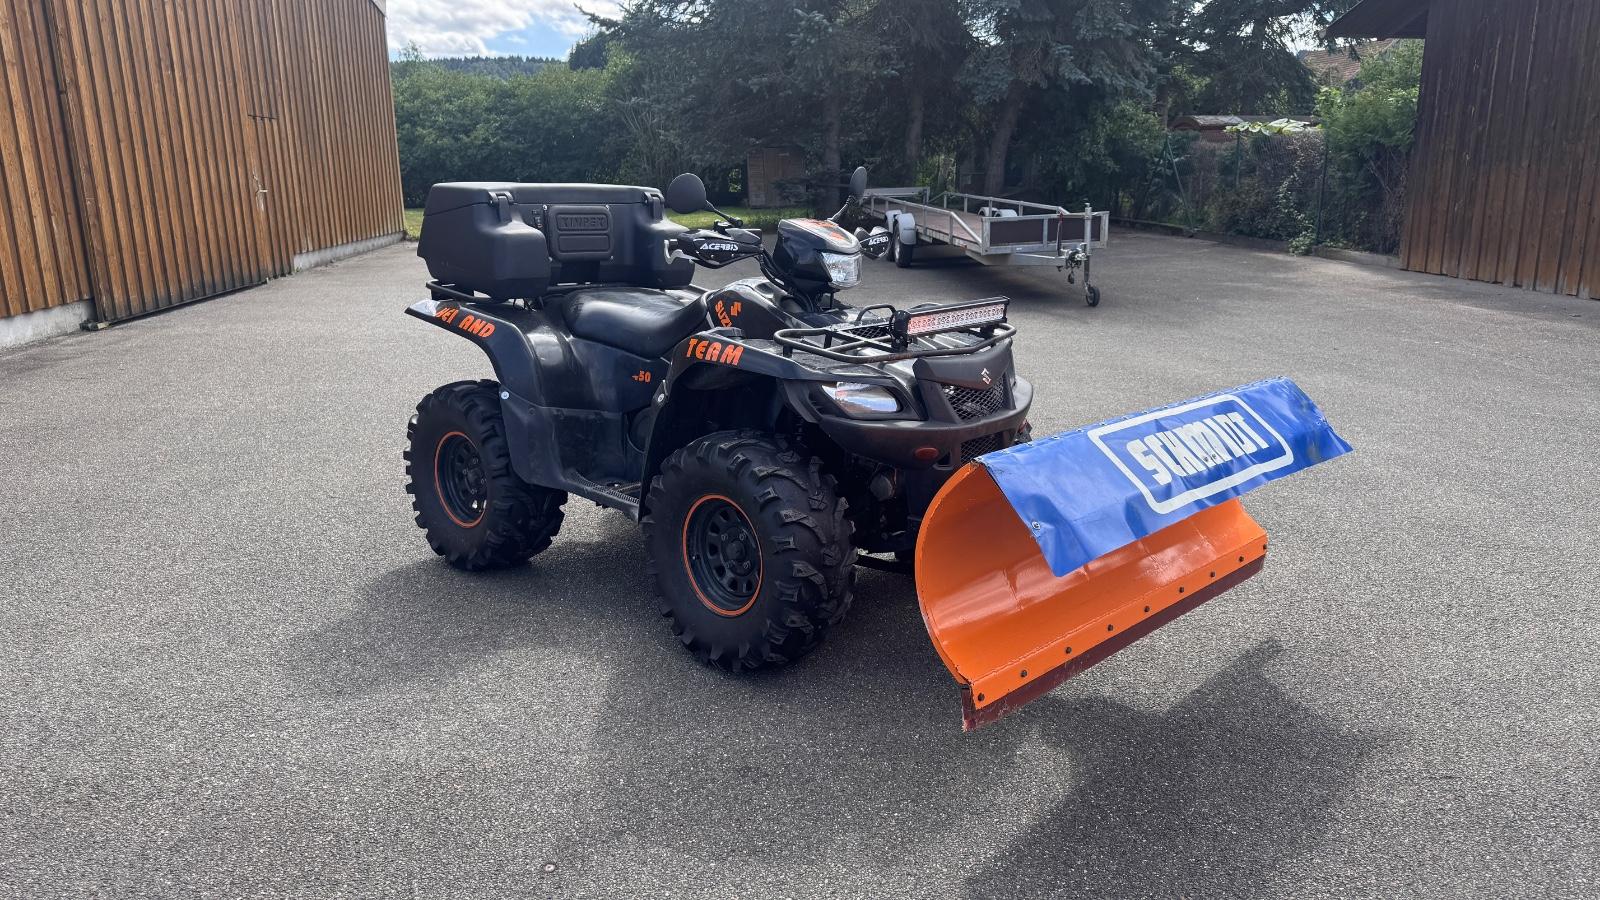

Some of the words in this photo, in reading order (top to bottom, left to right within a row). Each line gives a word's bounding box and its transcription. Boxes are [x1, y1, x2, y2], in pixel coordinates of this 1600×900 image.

[700, 243, 738, 251] ACERBIS
[686, 339, 744, 366] TEAM
[1126, 412, 1269, 486] SCHMIDT
